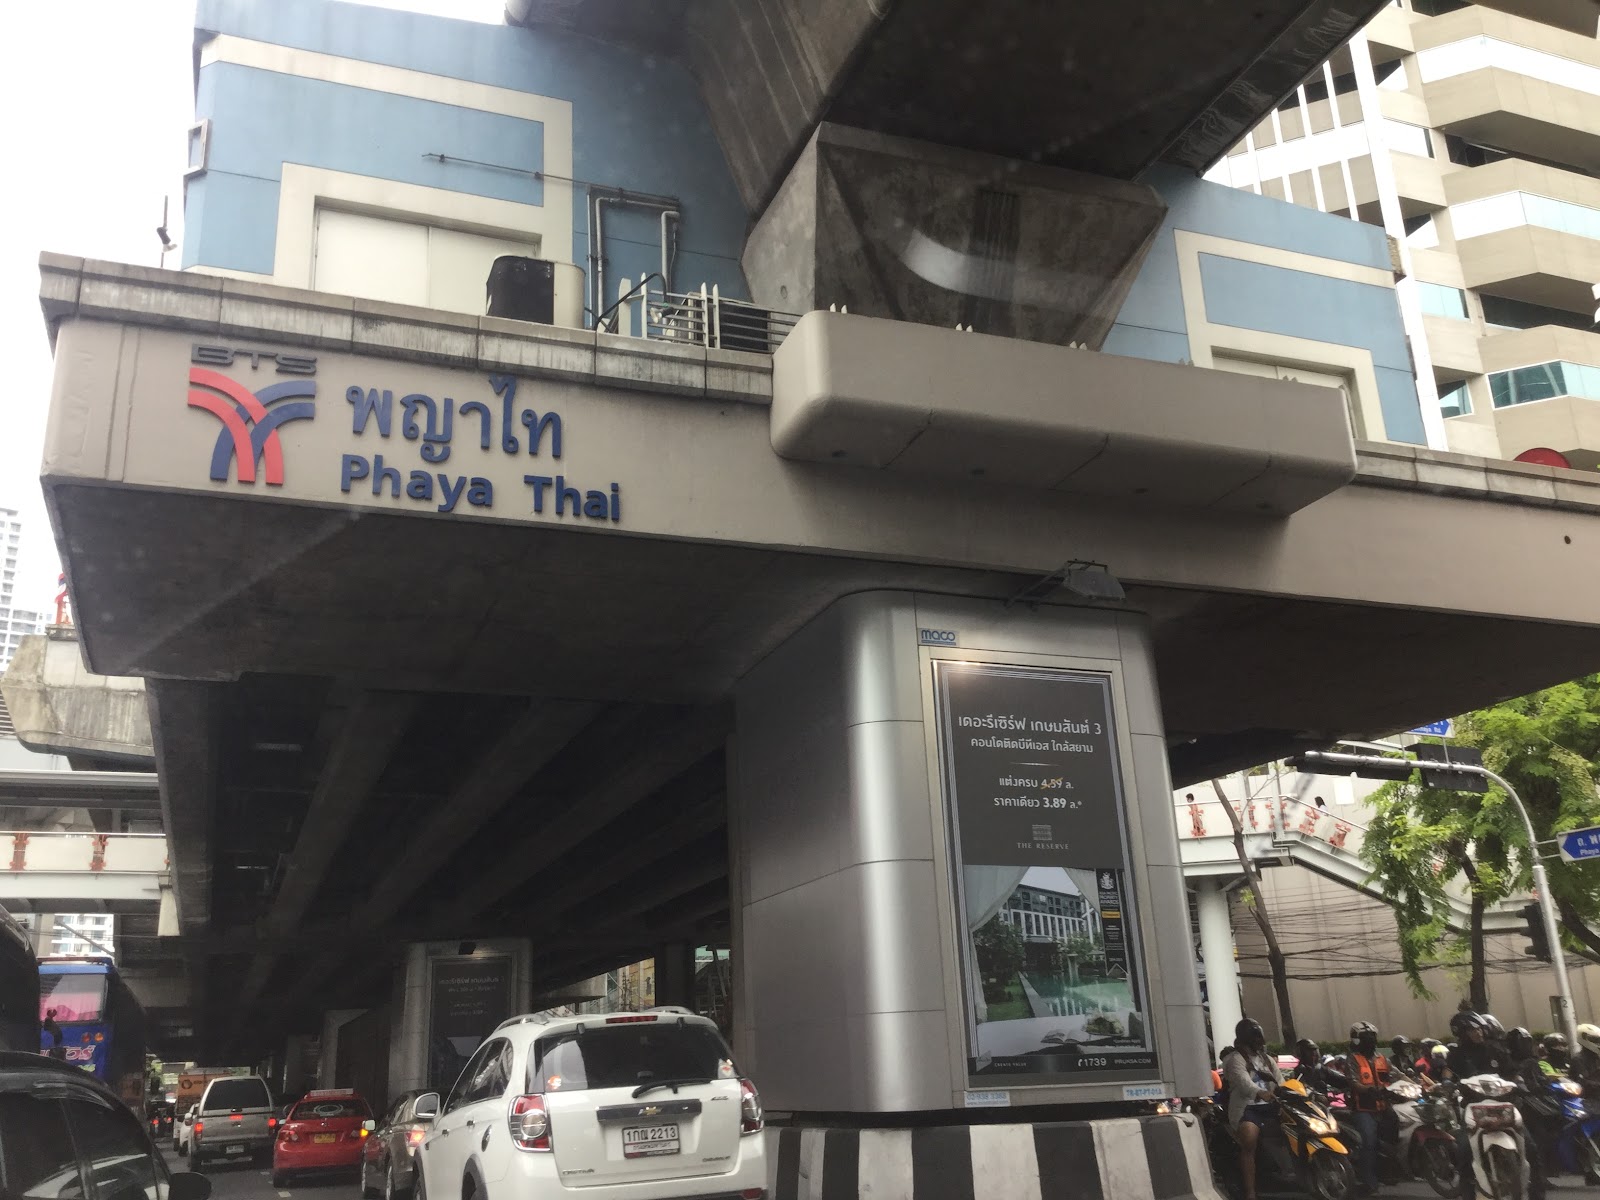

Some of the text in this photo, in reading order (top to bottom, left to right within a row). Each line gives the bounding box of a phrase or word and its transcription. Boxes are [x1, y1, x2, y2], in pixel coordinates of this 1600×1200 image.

[191, 343, 317, 376] BTS
[346, 373, 564, 464] พญาไท
[340, 453, 621, 522] Phaya Thai
[921, 629, 956, 641] maco
[958, 713, 1102, 735] เดอะรีเซิร์ฟ เกษมสันต์ 3
[970, 735, 1094, 753] คอนโดติดบีทีเอส ใกล้สยาม
[999, 775, 1038, 788] แต่งครบ
[994, 796, 1040, 808] ราคาเดียว
[1043, 797, 1067, 808] 3.89
[1084, 1057, 1107, 1067] 1739
[650, 1127, 676, 1140] 2213
